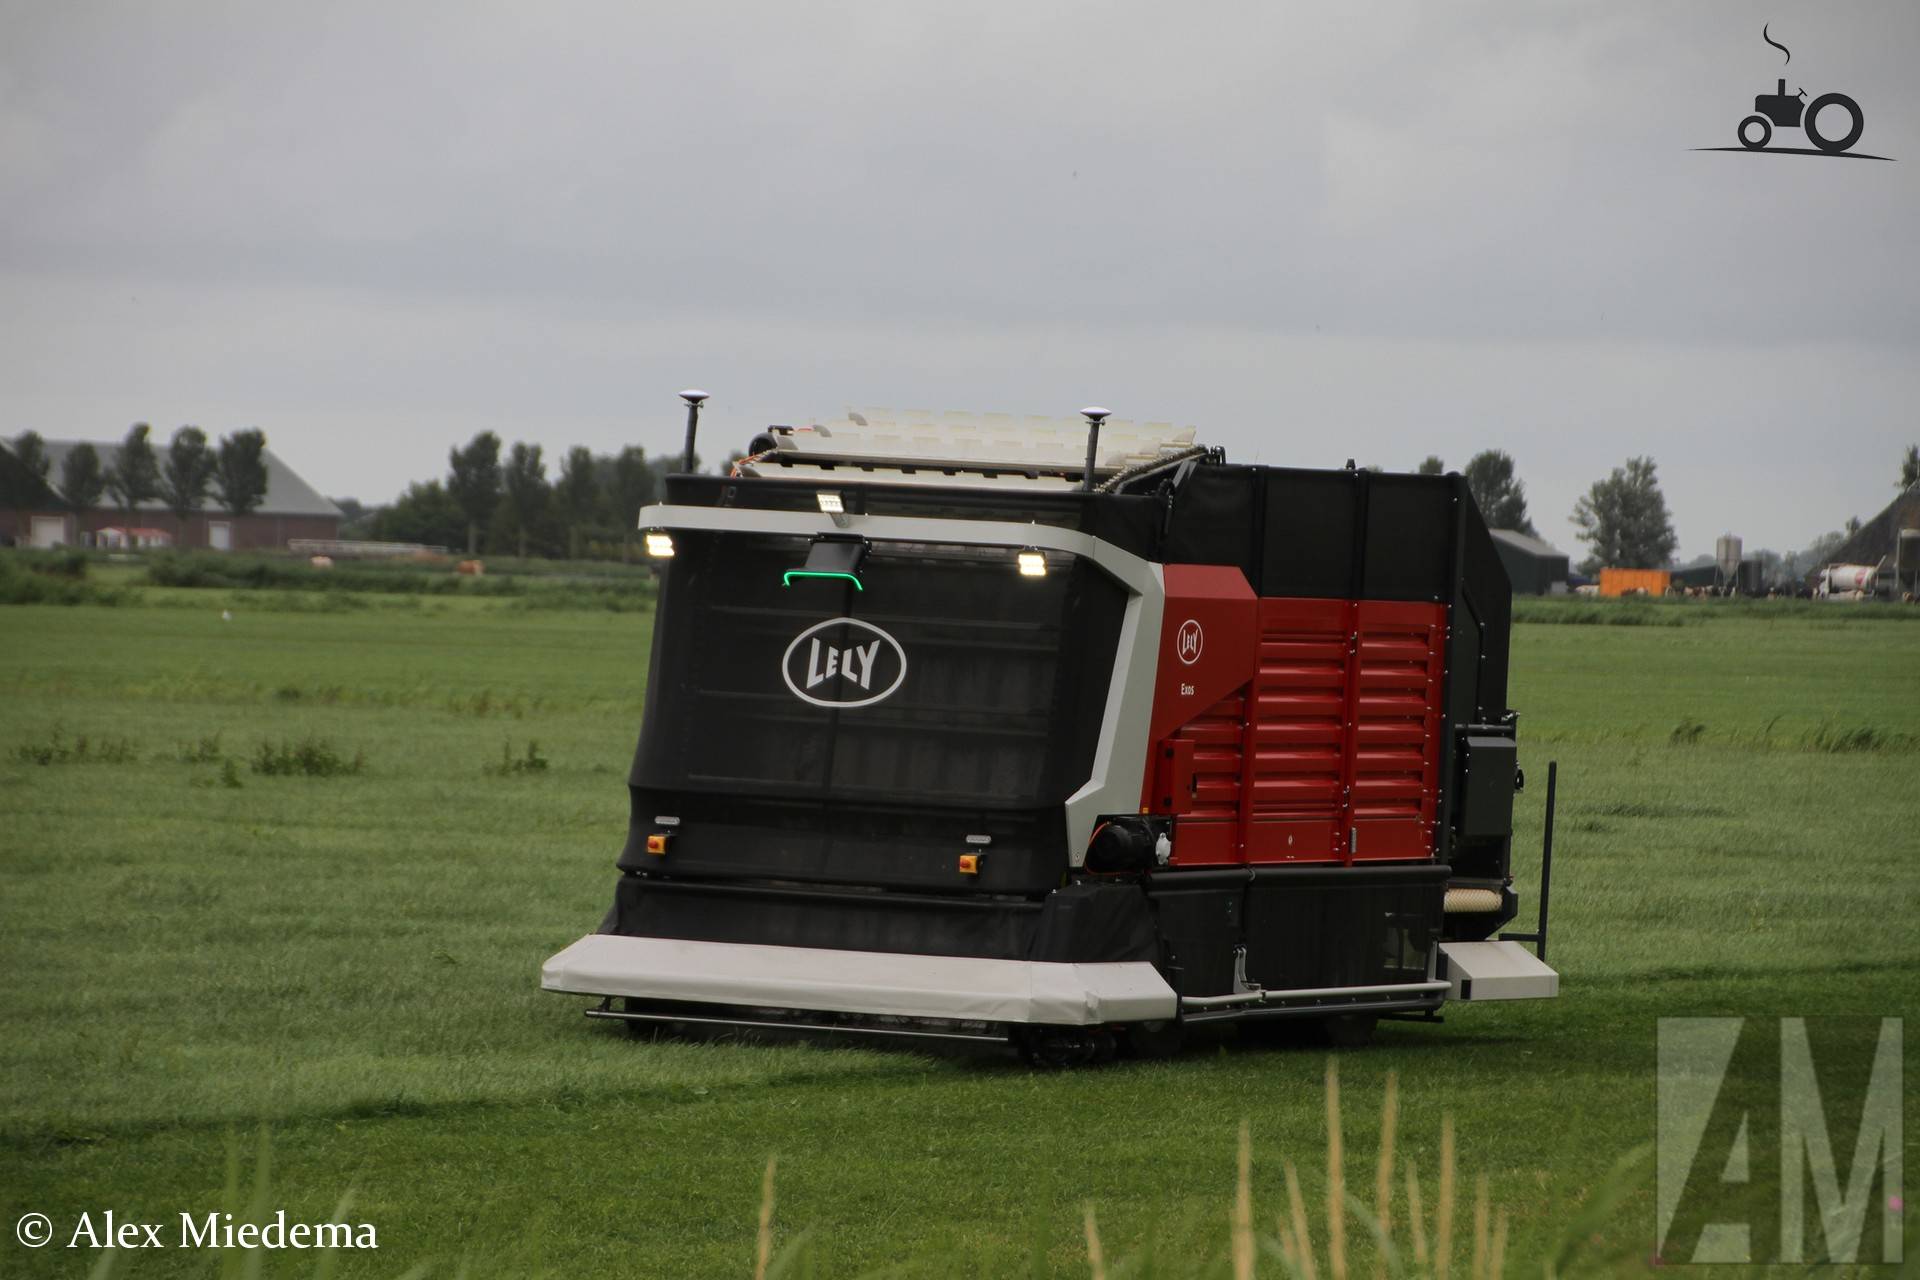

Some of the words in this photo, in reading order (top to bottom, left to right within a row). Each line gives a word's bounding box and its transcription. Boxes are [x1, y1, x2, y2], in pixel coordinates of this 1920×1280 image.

[1182, 628, 1199, 655] LELY
[806, 637, 880, 690] LELY
[1181, 683, 1195, 696] Exos
